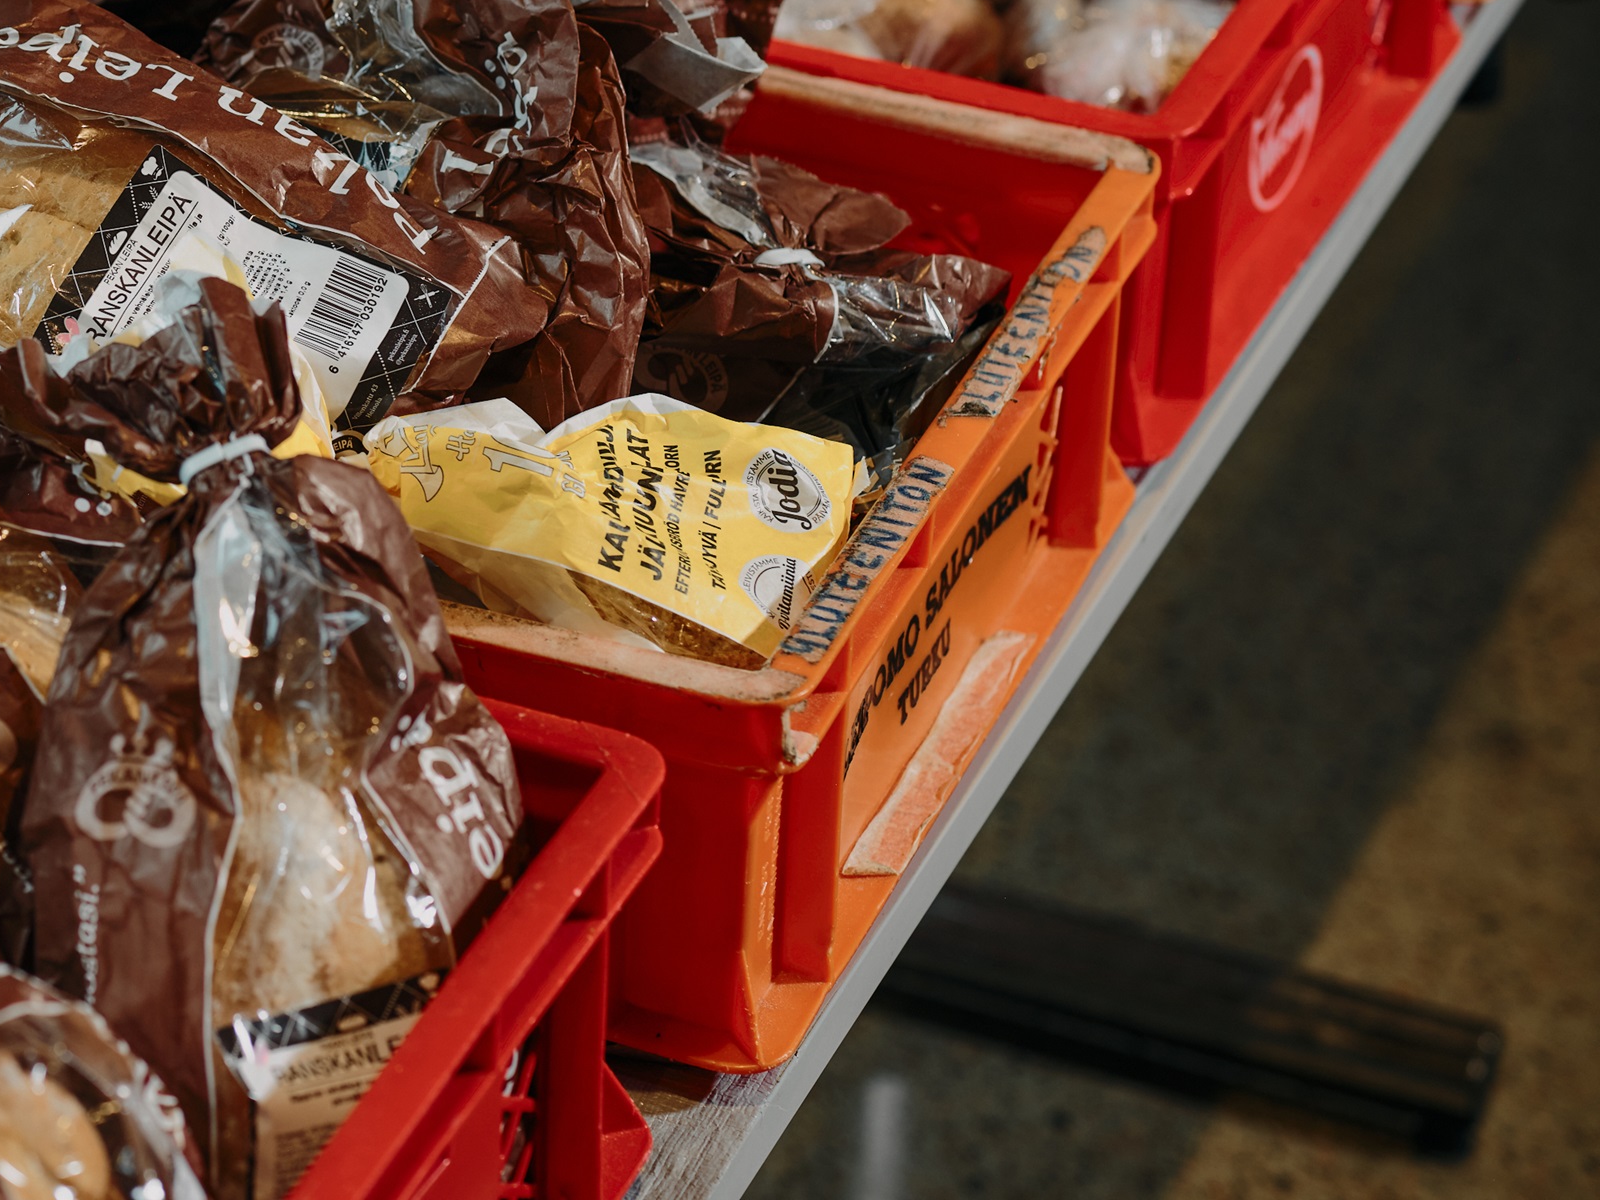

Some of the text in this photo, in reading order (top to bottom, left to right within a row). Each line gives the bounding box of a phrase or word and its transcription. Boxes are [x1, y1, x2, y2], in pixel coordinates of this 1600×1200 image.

[104, 238, 138, 286] PEKAN LEIPÄ
[329, 277, 388, 374] 6 416147 030192
[366, 397, 382, 419] Heinola
[370, 383, 379, 393] 43
[766, 449, 813, 530] Jodia
[925, 463, 1032, 631] SALONEN
[897, 616, 952, 726] TURKU
